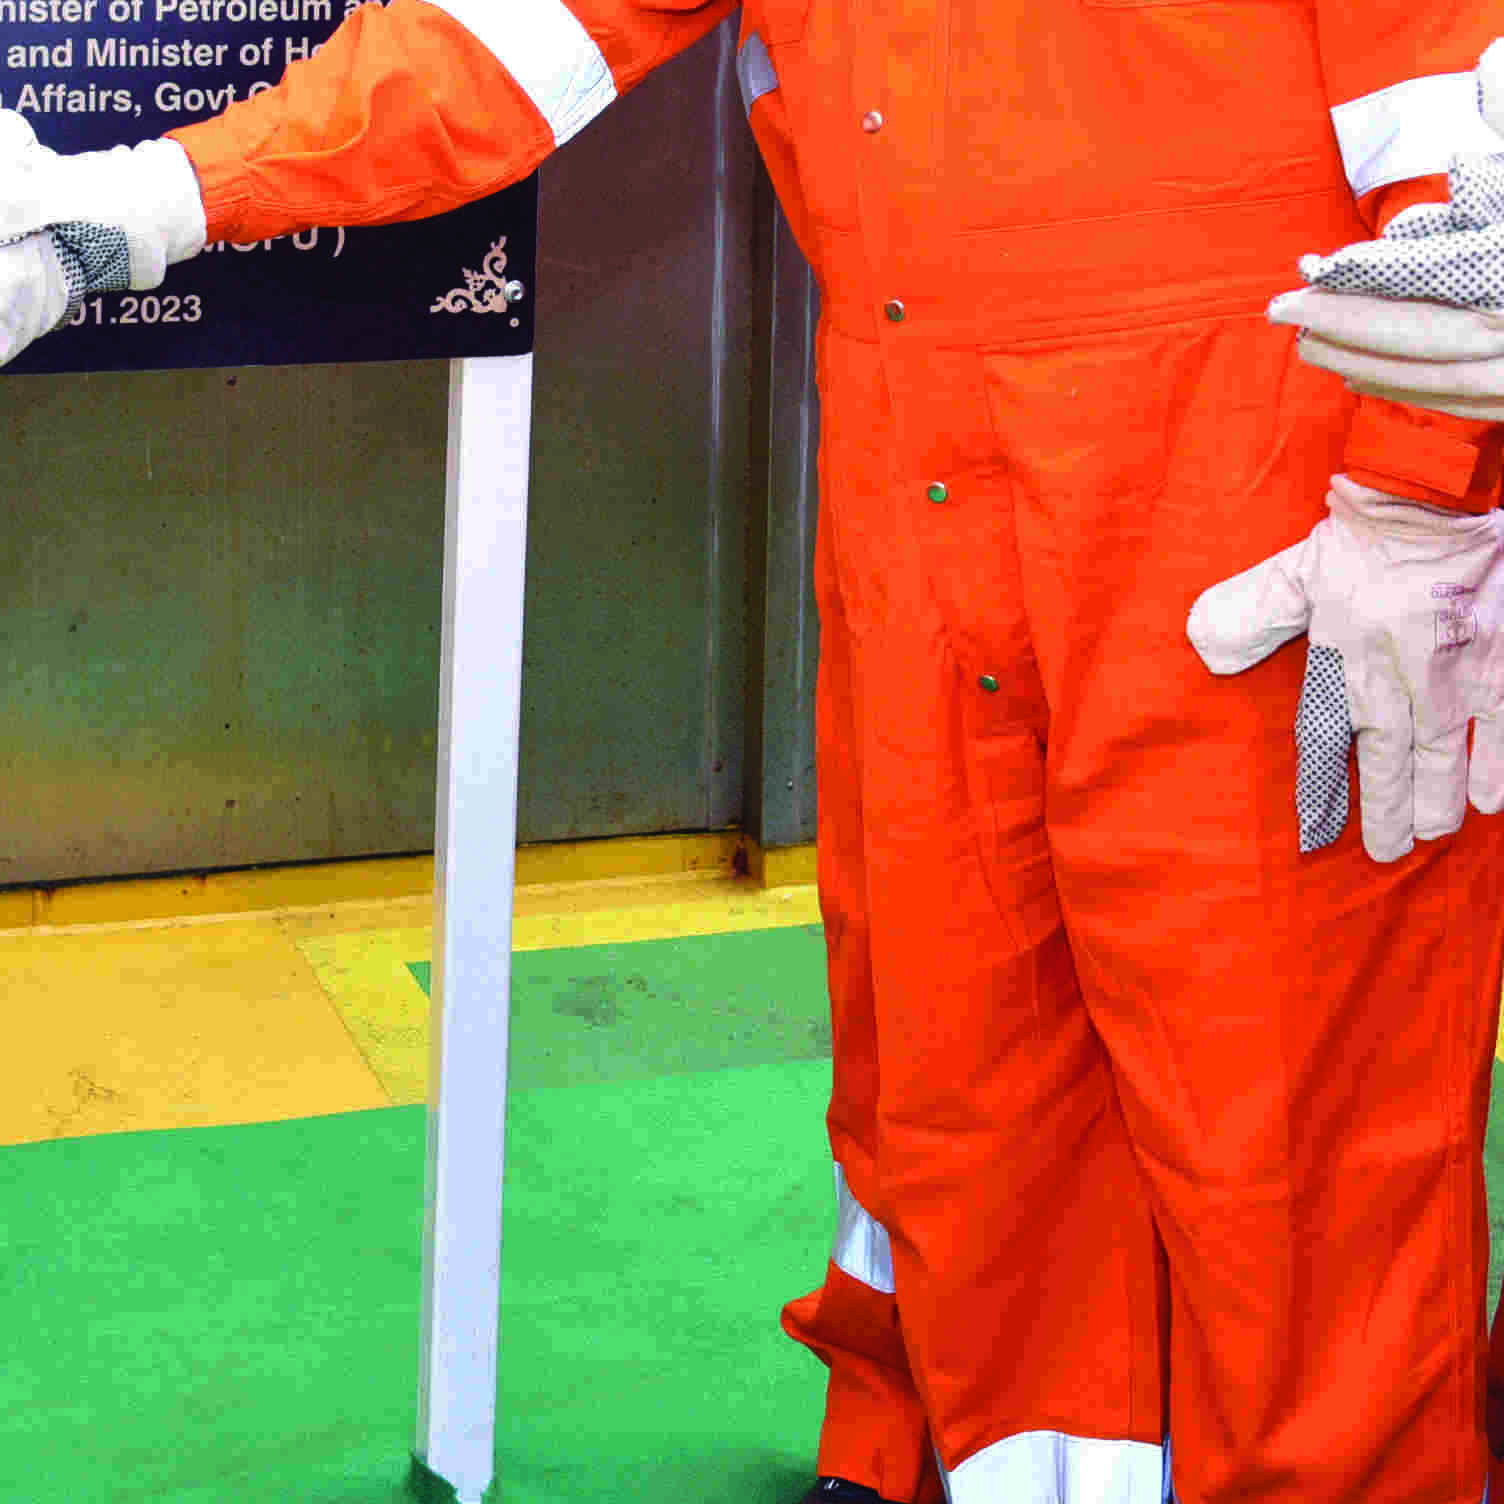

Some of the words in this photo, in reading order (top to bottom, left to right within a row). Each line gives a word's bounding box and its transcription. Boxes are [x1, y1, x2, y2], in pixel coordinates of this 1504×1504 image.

[7, 38, 73, 68] and
[87, 37, 229, 67] Minister
[239, 37, 273, 66] of
[16, 82, 142, 117] Affairs,
